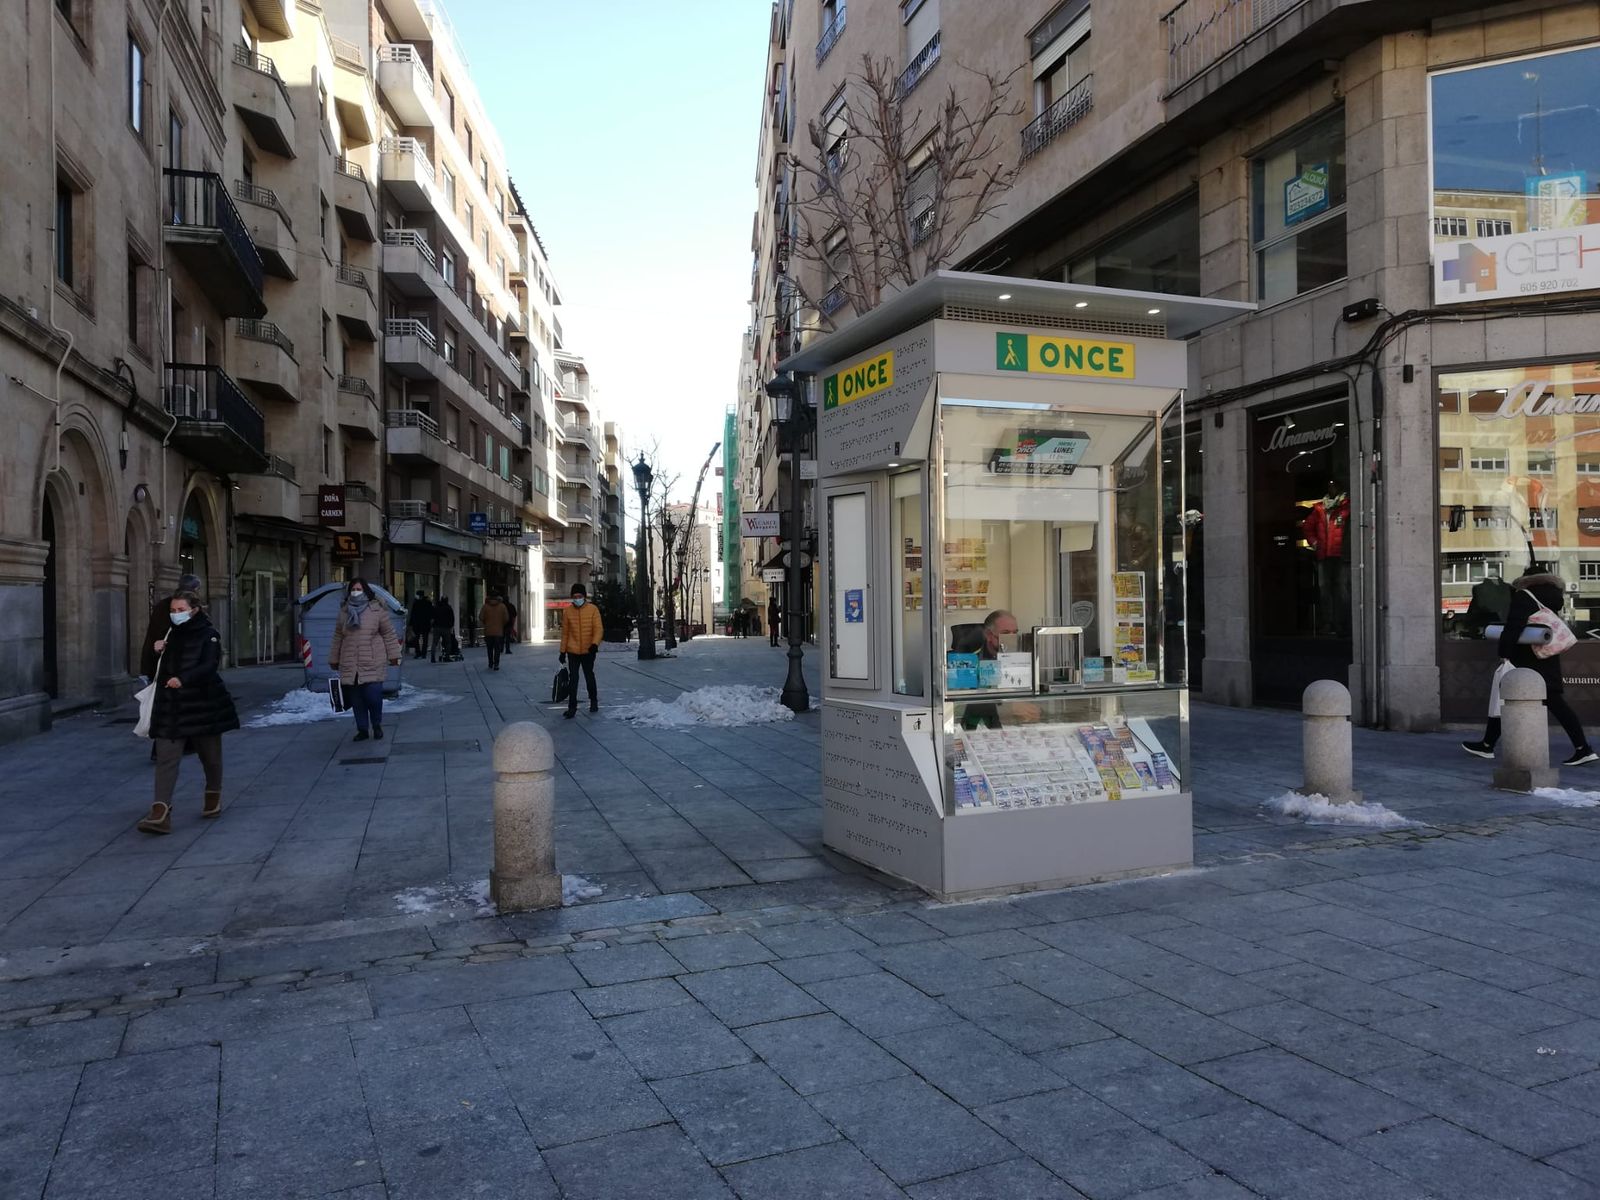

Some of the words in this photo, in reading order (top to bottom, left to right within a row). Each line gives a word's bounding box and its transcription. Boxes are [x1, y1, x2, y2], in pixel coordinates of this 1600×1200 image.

[1520, 283, 1538, 293] 605
[1540, 281, 1558, 291] 920
[1560, 278, 1579, 289] 702
[1039, 342, 1124, 373] ONCE
[843, 358, 888, 397] ONCE
[324, 493, 340, 502] DOÑA
[321, 509, 343, 517] CARMEN
